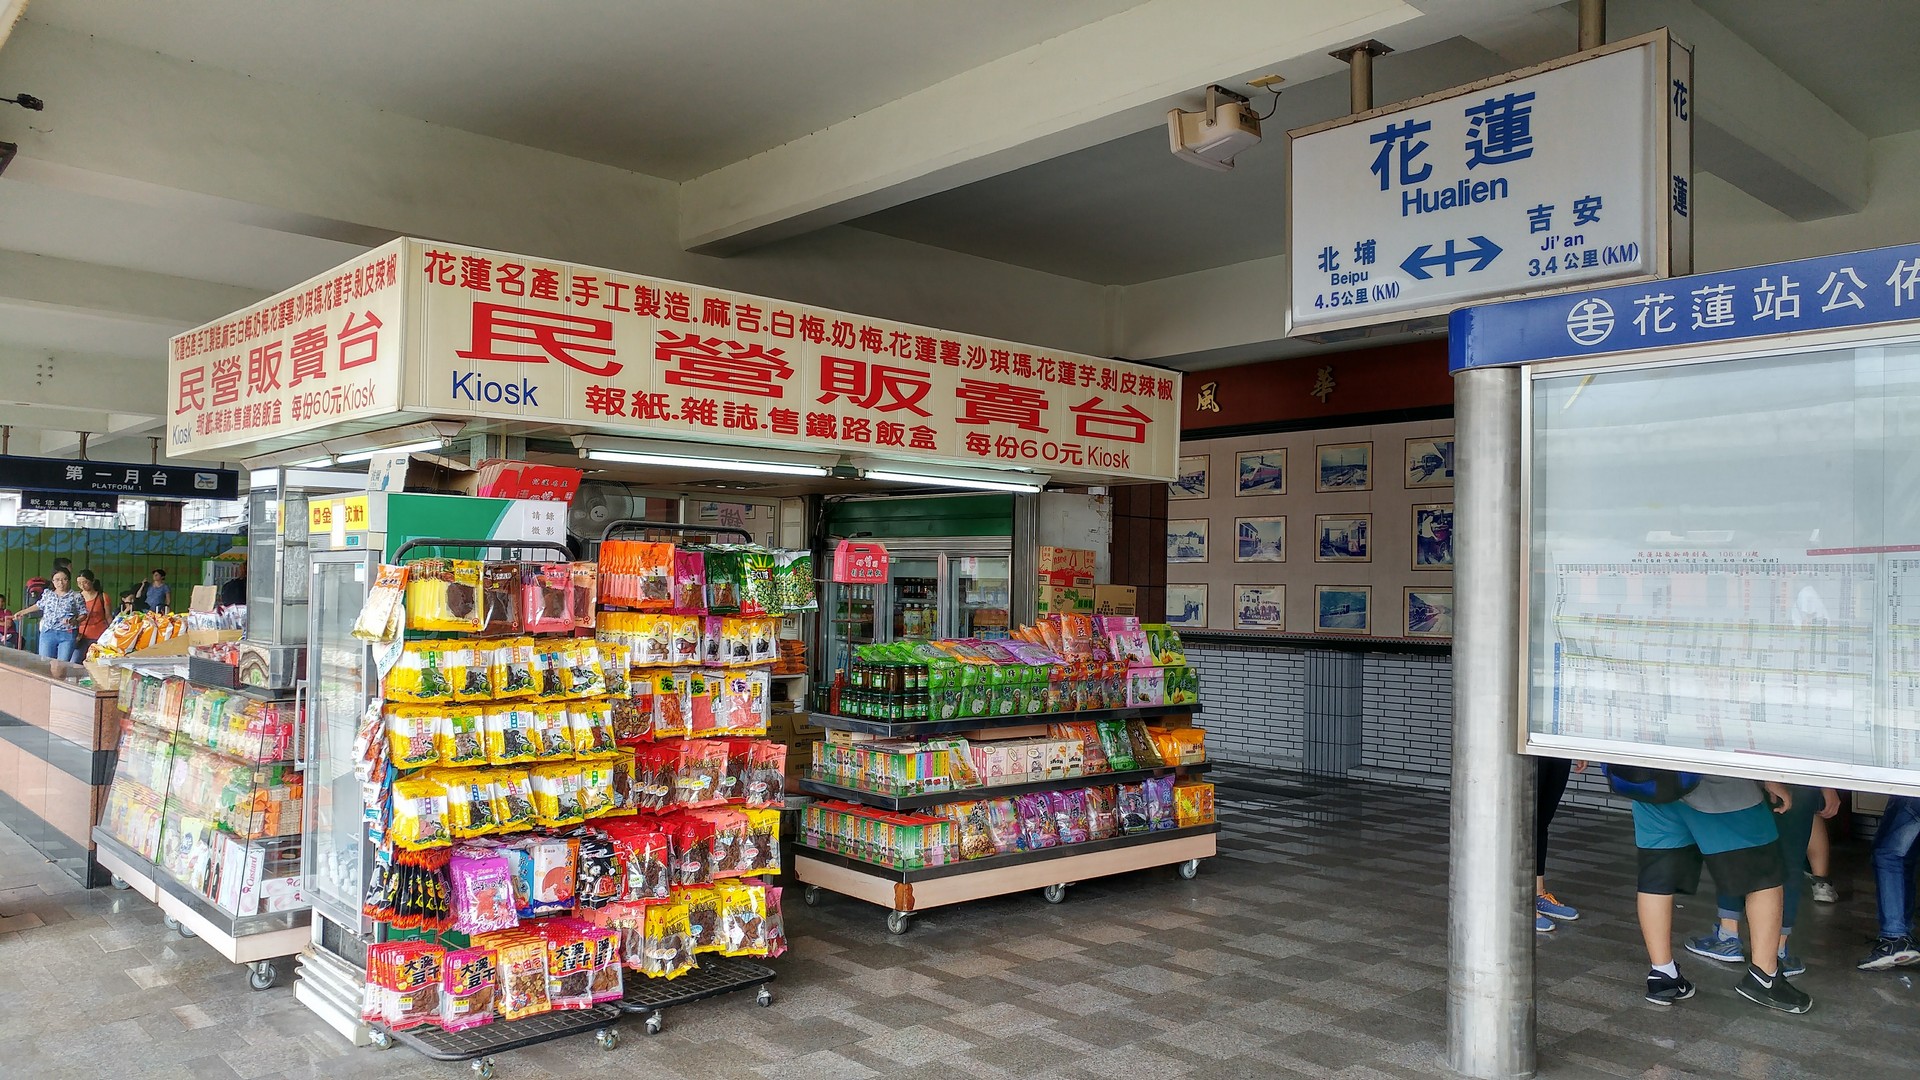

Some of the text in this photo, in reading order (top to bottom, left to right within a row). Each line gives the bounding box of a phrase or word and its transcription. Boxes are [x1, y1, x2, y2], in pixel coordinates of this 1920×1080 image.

[1369, 91, 1536, 191] 花蓮
[1673, 79, 1689, 219] 花蓮
[1402, 175, 1508, 217] Hualien
[1526, 195, 1603, 235] 吉安
[1318, 240, 1377, 273] 北埔
[1330, 269, 1369, 286] Beipu
[175, 310, 384, 416] 民營販賣台
[456, 301, 1154, 444] 民營販賣台
[342, 378, 376, 412] Kiosk
[452, 370, 539, 408] Kiosk
[172, 424, 192, 446] Kiosk
[965, 431, 1130, 469] 每份60元 Kiosk
[65, 464, 168, 487] 第一月台
[91, 482, 135, 491] PLATFORM
[322, 505, 363, 524] 金飲料
[555, 942, 585, 960] 大溪
[561, 953, 591, 972] 豆干
[404, 953, 434, 975] 大溪
[411, 965, 440, 986] 豆干
[460, 956, 489, 979] 大溪
[467, 967, 496, 989] 豆干
